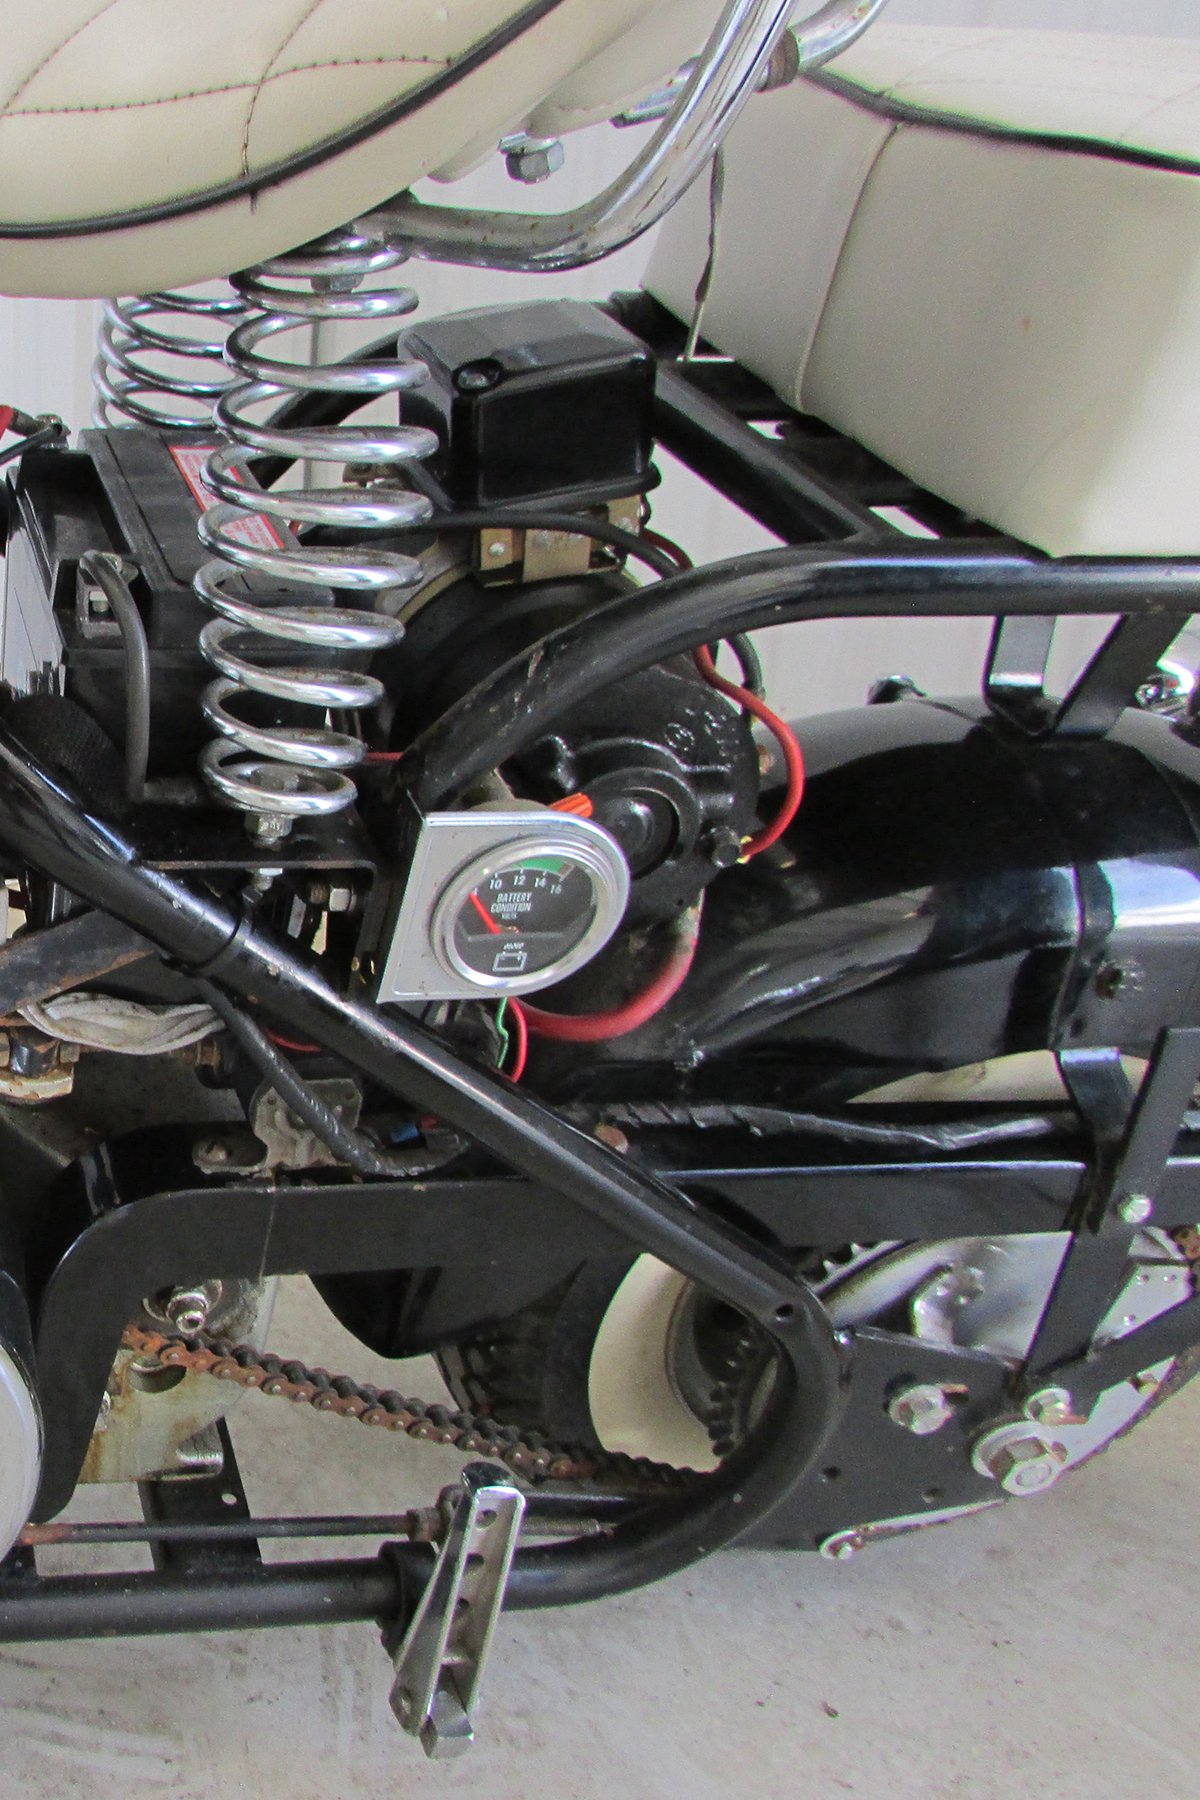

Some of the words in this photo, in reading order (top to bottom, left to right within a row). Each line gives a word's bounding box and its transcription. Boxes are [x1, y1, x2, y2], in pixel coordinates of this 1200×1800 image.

[489, 878, 502, 890] 10
[513, 875, 526, 886] 12
[534, 877, 547, 888] 14
[550, 884, 562, 895] 16
[496, 892, 533, 903] BATTERY
[490, 902, 532, 913] CONDITION
